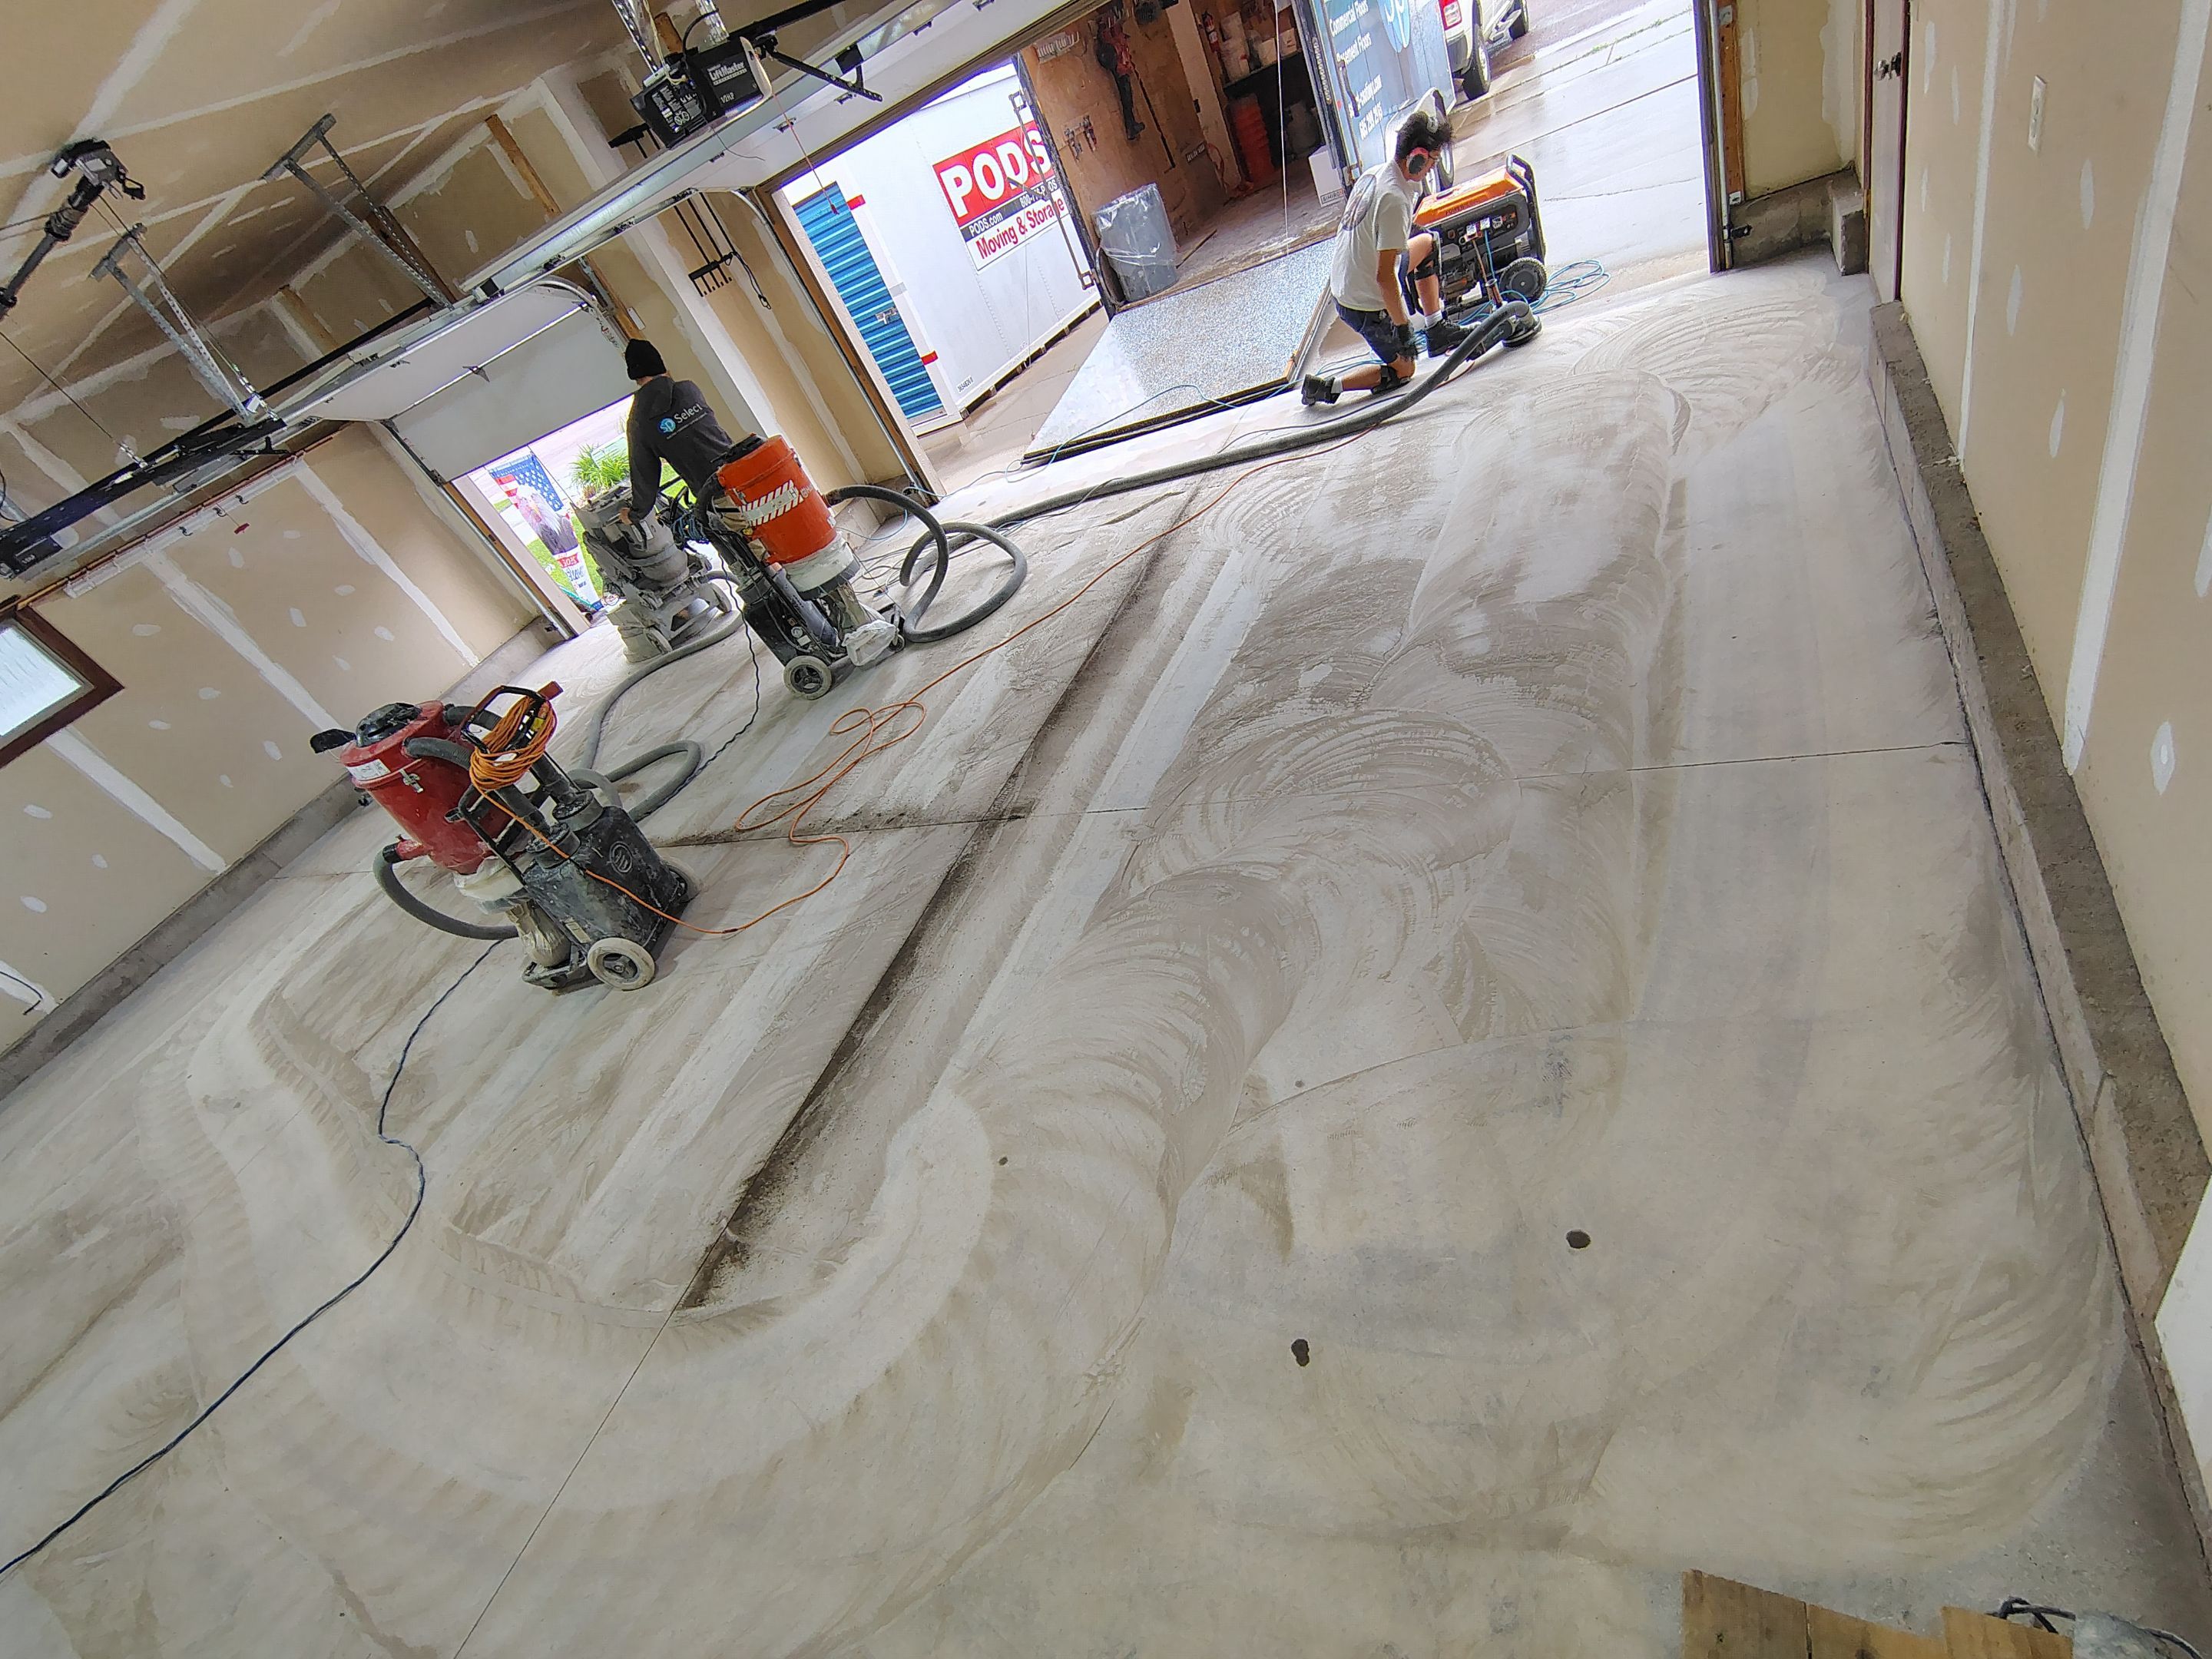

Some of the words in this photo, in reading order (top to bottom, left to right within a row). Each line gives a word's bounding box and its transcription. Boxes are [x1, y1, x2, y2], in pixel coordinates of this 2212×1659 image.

[1330, 2, 1356, 37] Commercial
[1356, 31, 1372, 54] Floors
[709, 61, 745, 81] LiftMaster
[939, 128, 1051, 218] PODS
[969, 212, 1003, 237] PODS.com
[975, 228, 1018, 260] Moving
[1016, 217, 1028, 235] &
[674, 402, 704, 424] Select
